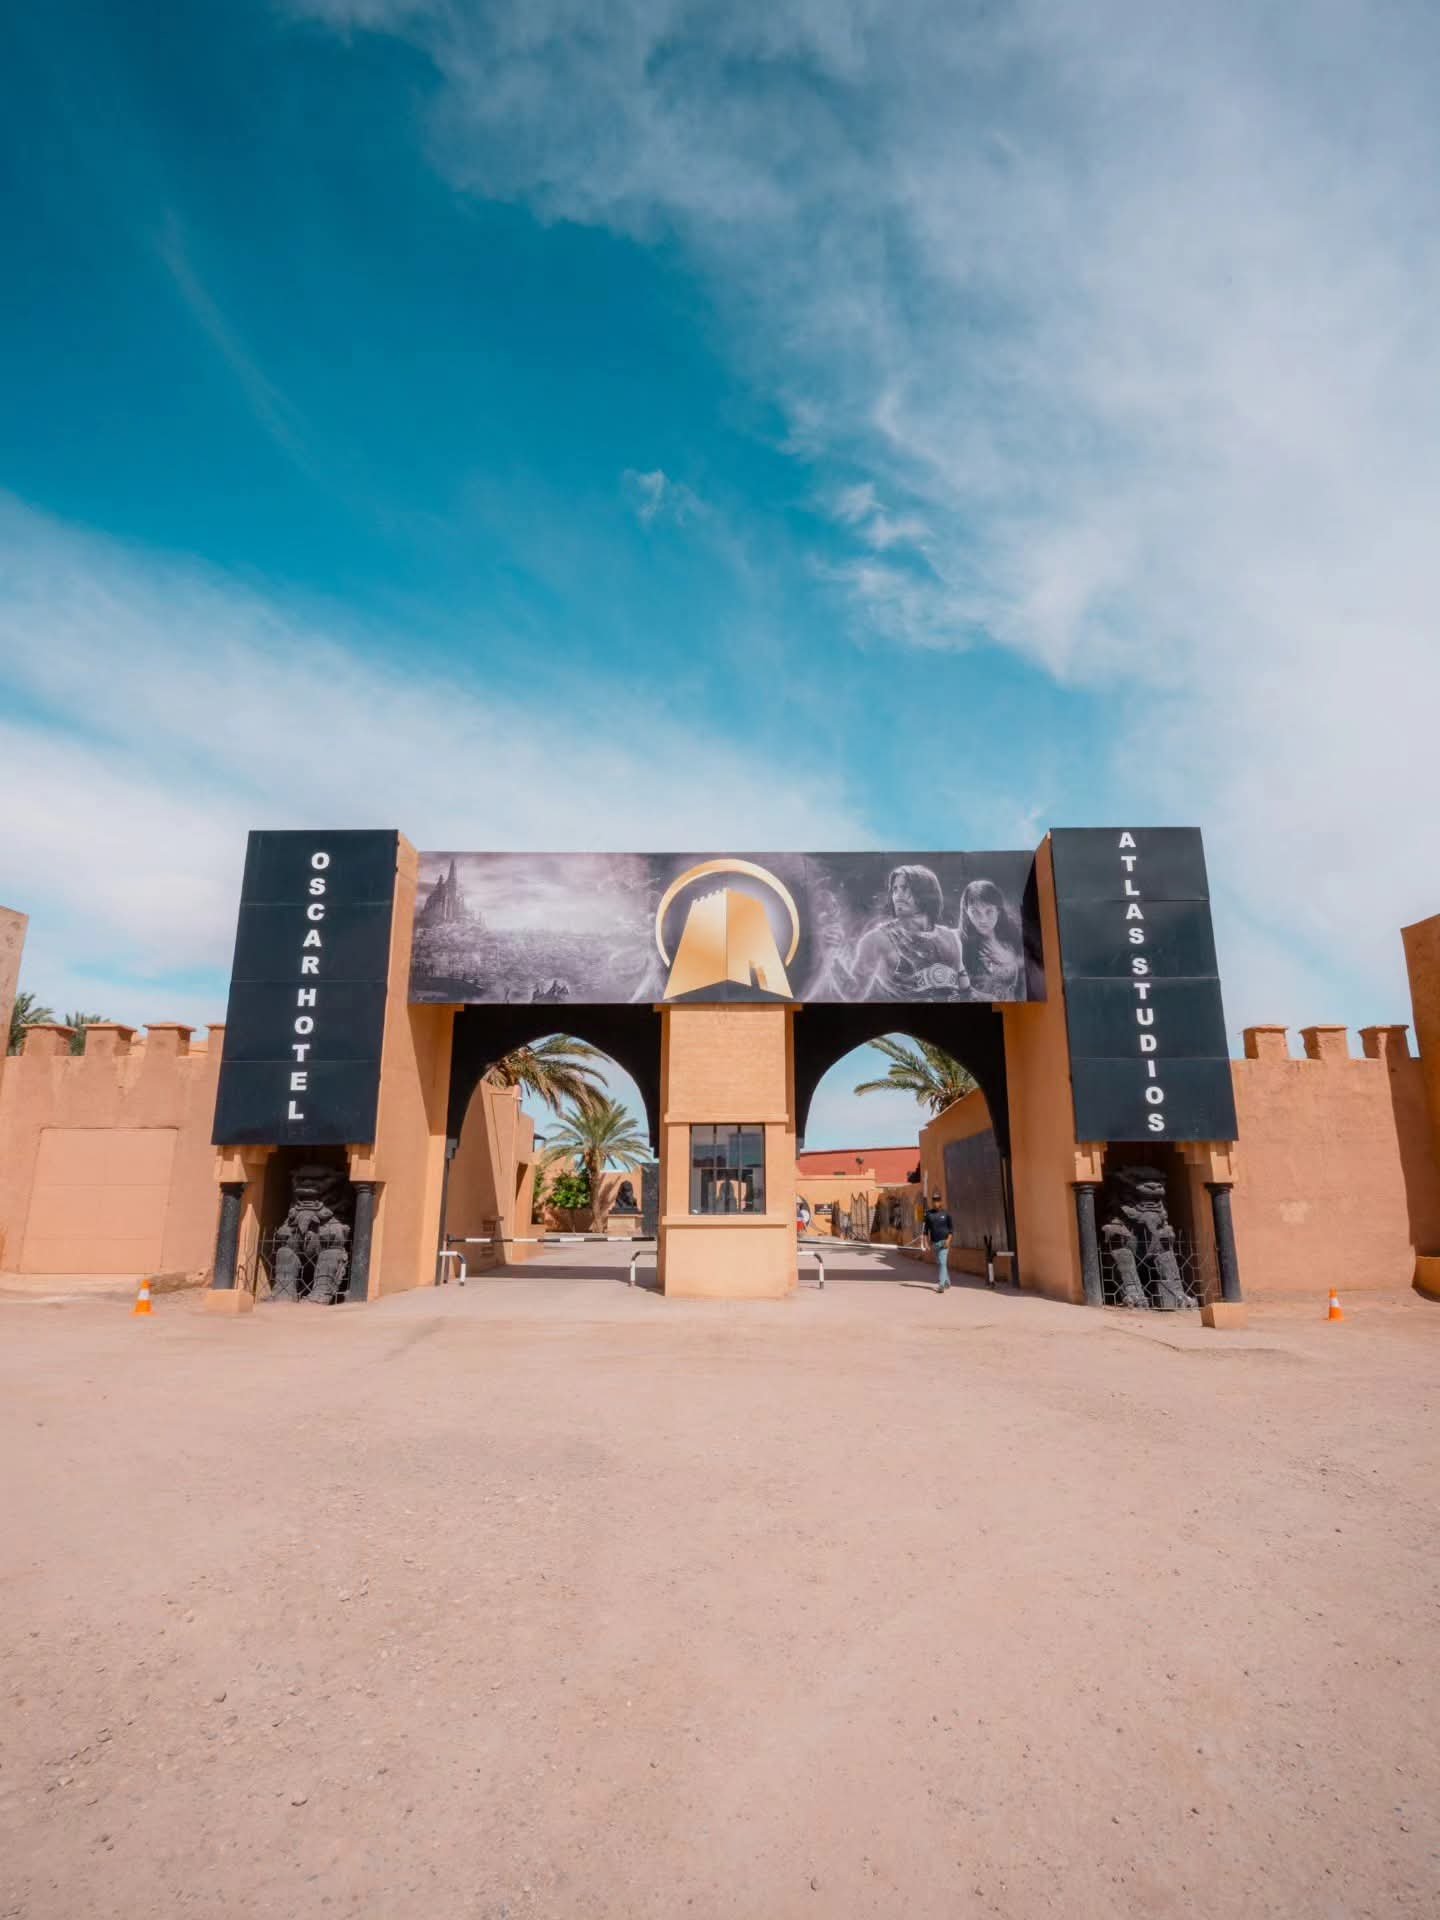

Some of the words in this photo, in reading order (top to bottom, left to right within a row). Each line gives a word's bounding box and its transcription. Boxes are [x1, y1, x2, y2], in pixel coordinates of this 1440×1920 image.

[301, 852, 330, 975] OSCAR
[1118, 831, 1145, 945] ATLAS
[288, 988, 317, 1120] HOTEL
[1131, 957, 1165, 1132] STUDIOS
